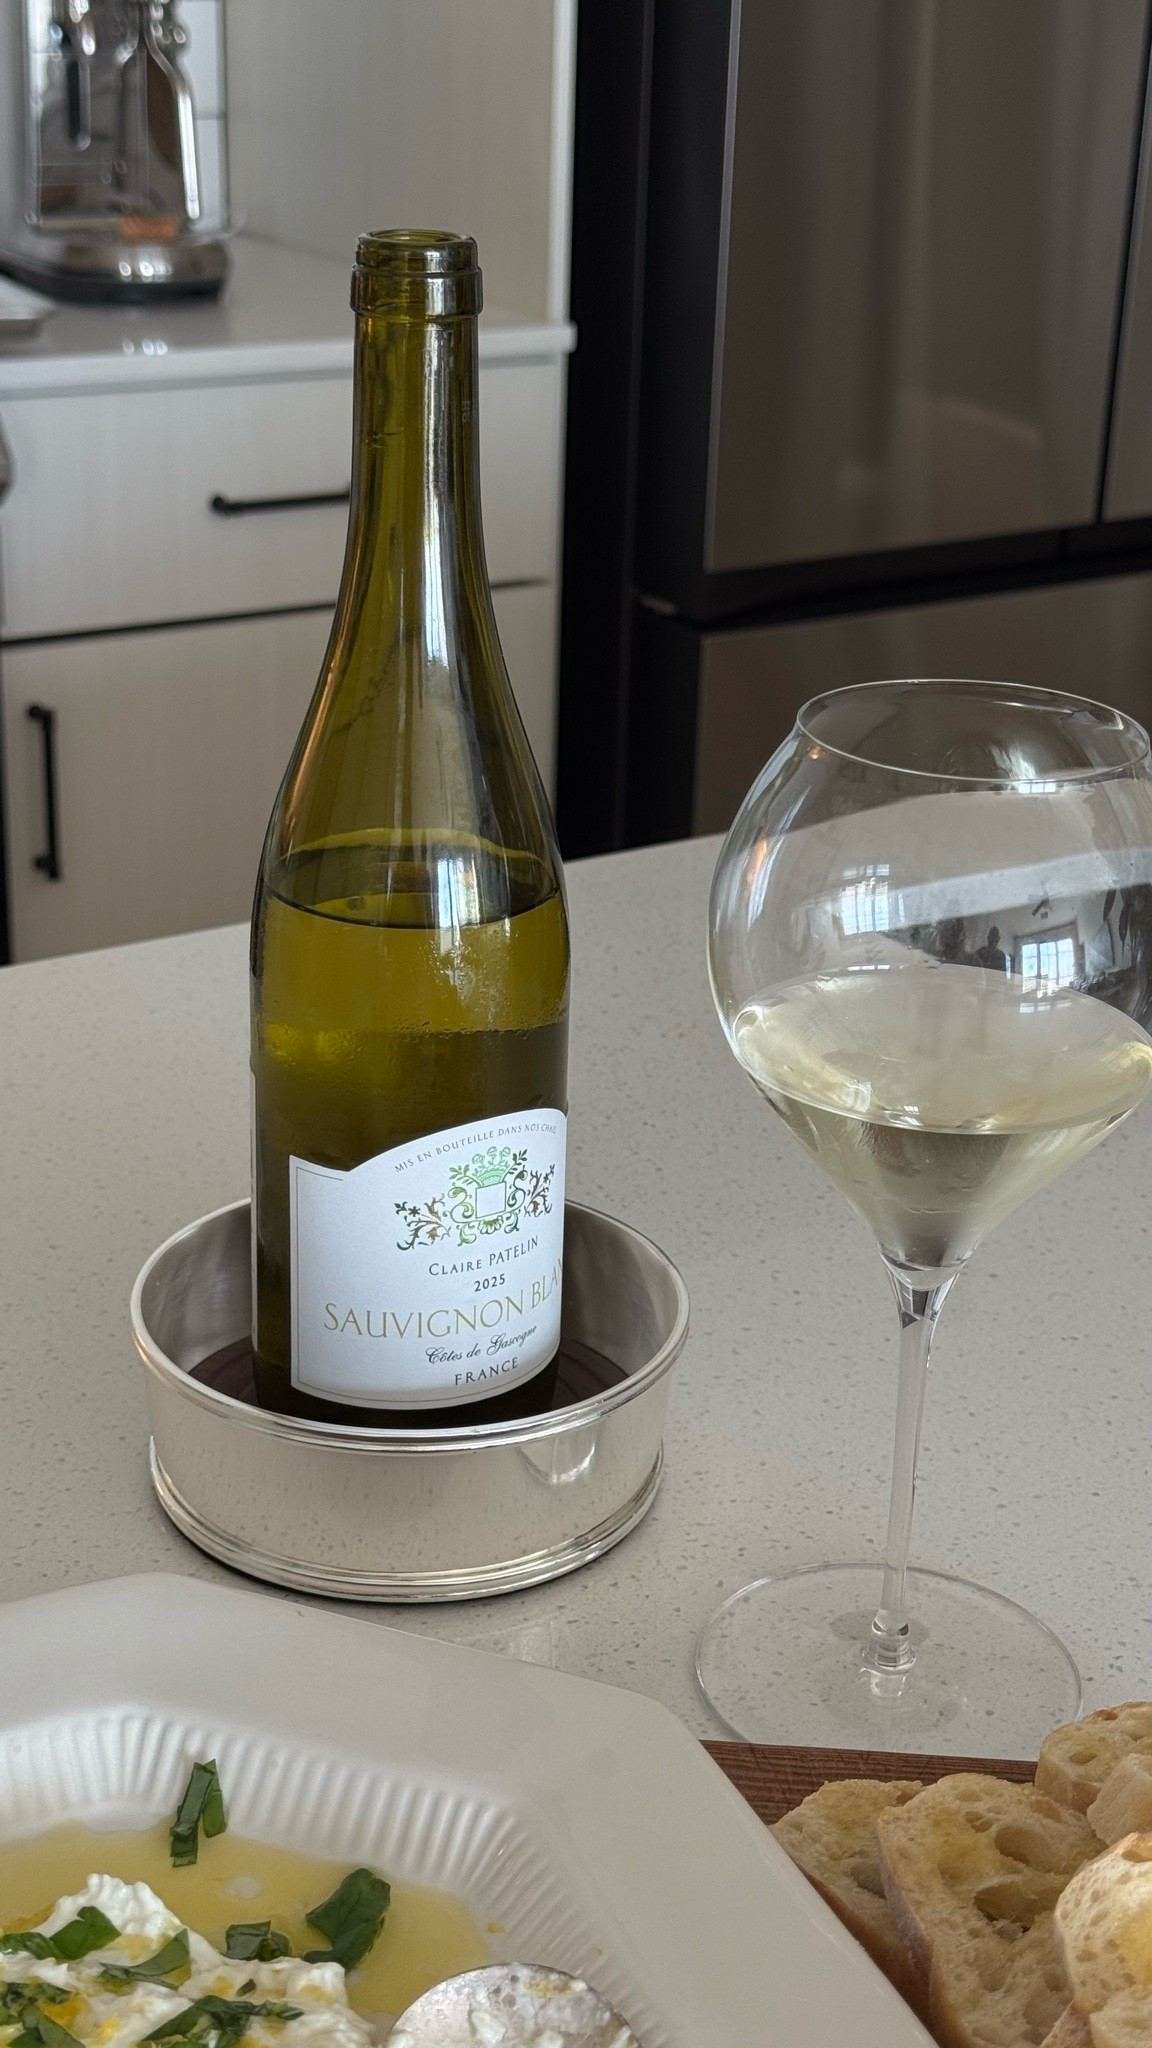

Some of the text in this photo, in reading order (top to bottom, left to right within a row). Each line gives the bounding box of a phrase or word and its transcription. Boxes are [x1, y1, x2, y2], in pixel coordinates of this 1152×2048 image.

[394, 1158, 414, 1173] MIS
[417, 1151, 432, 1162] EN
[436, 1131, 494, 1155] BOUTEILLE
[498, 1125, 522, 1137] DANS
[524, 1123, 540, 1132] NOS
[428, 1235, 539, 1276] CLAIRE PATELIN
[473, 1273, 506, 1293] 2025
[324, 1290, 523, 1339] SAUVIGNON
[425, 1325, 538, 1365] Côtes de Gascogne
[454, 1357, 518, 1386] FRANCE
